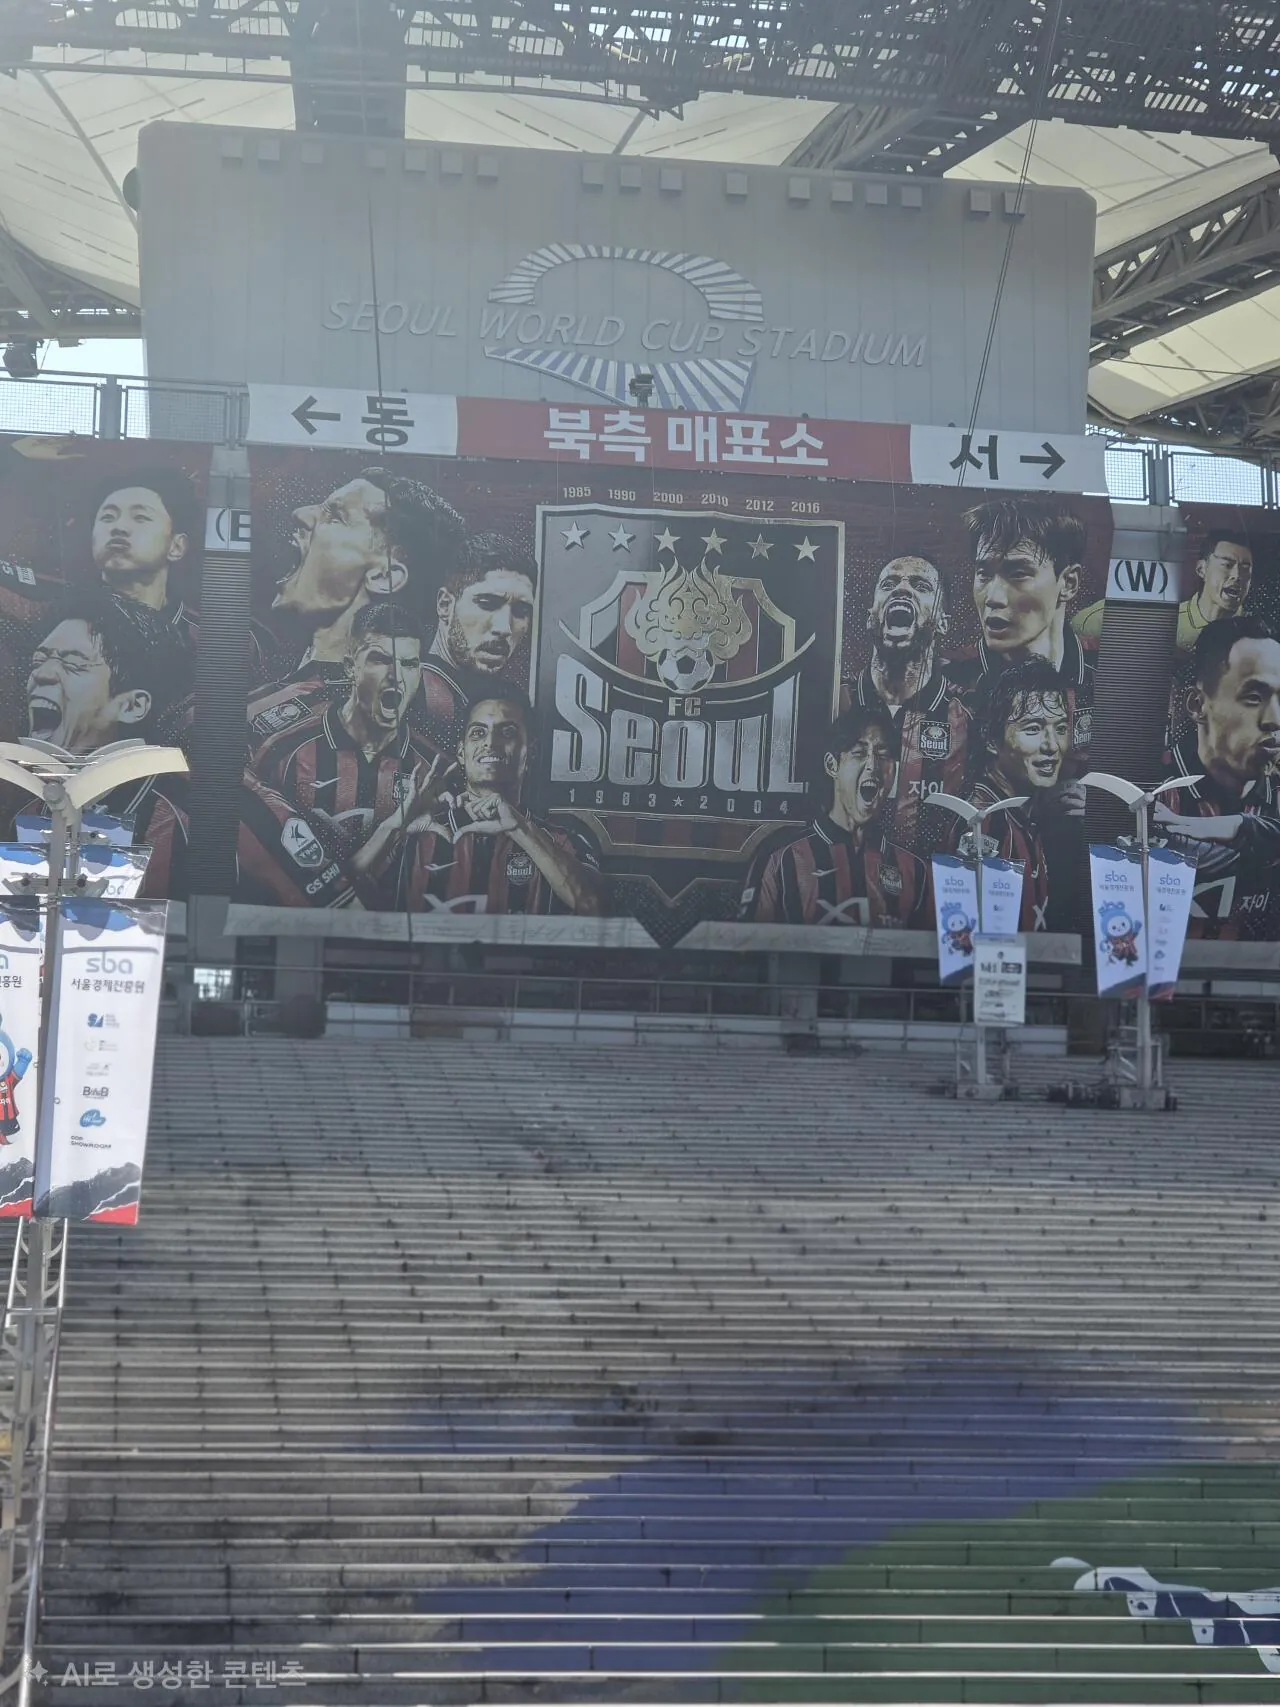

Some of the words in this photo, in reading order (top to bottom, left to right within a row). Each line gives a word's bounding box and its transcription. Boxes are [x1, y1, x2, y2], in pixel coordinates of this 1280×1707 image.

[322, 301, 456, 336] SEOUL
[479, 305, 626, 346] WORLD
[640, 319, 725, 353] CUP
[736, 326, 927, 366] STADIUM
[361, 396, 414, 446] 동
[543, 407, 651, 462] 북측
[667, 416, 829, 466] 매표소
[949, 435, 999, 480] 서
[563, 487, 591, 498] 1985
[608, 489, 636, 501] 1990
[653, 491, 683, 504] 2000
[701, 493, 728, 507] 2010
[746, 499, 774, 512] 2012
[792, 501, 820, 514] 2016
[1114, 559, 1168, 594] (W)
[668, 697, 701, 716] FC
[550, 654, 809, 793] Seoul
[920, 735, 948, 750] Seoul
[908, 780, 944, 800] 자이
[1105, 871, 1128, 883] sba
[1159, 873, 1181, 886] sba
[1239, 892, 1270, 914] 자이
[85, 951, 133, 974] sba
